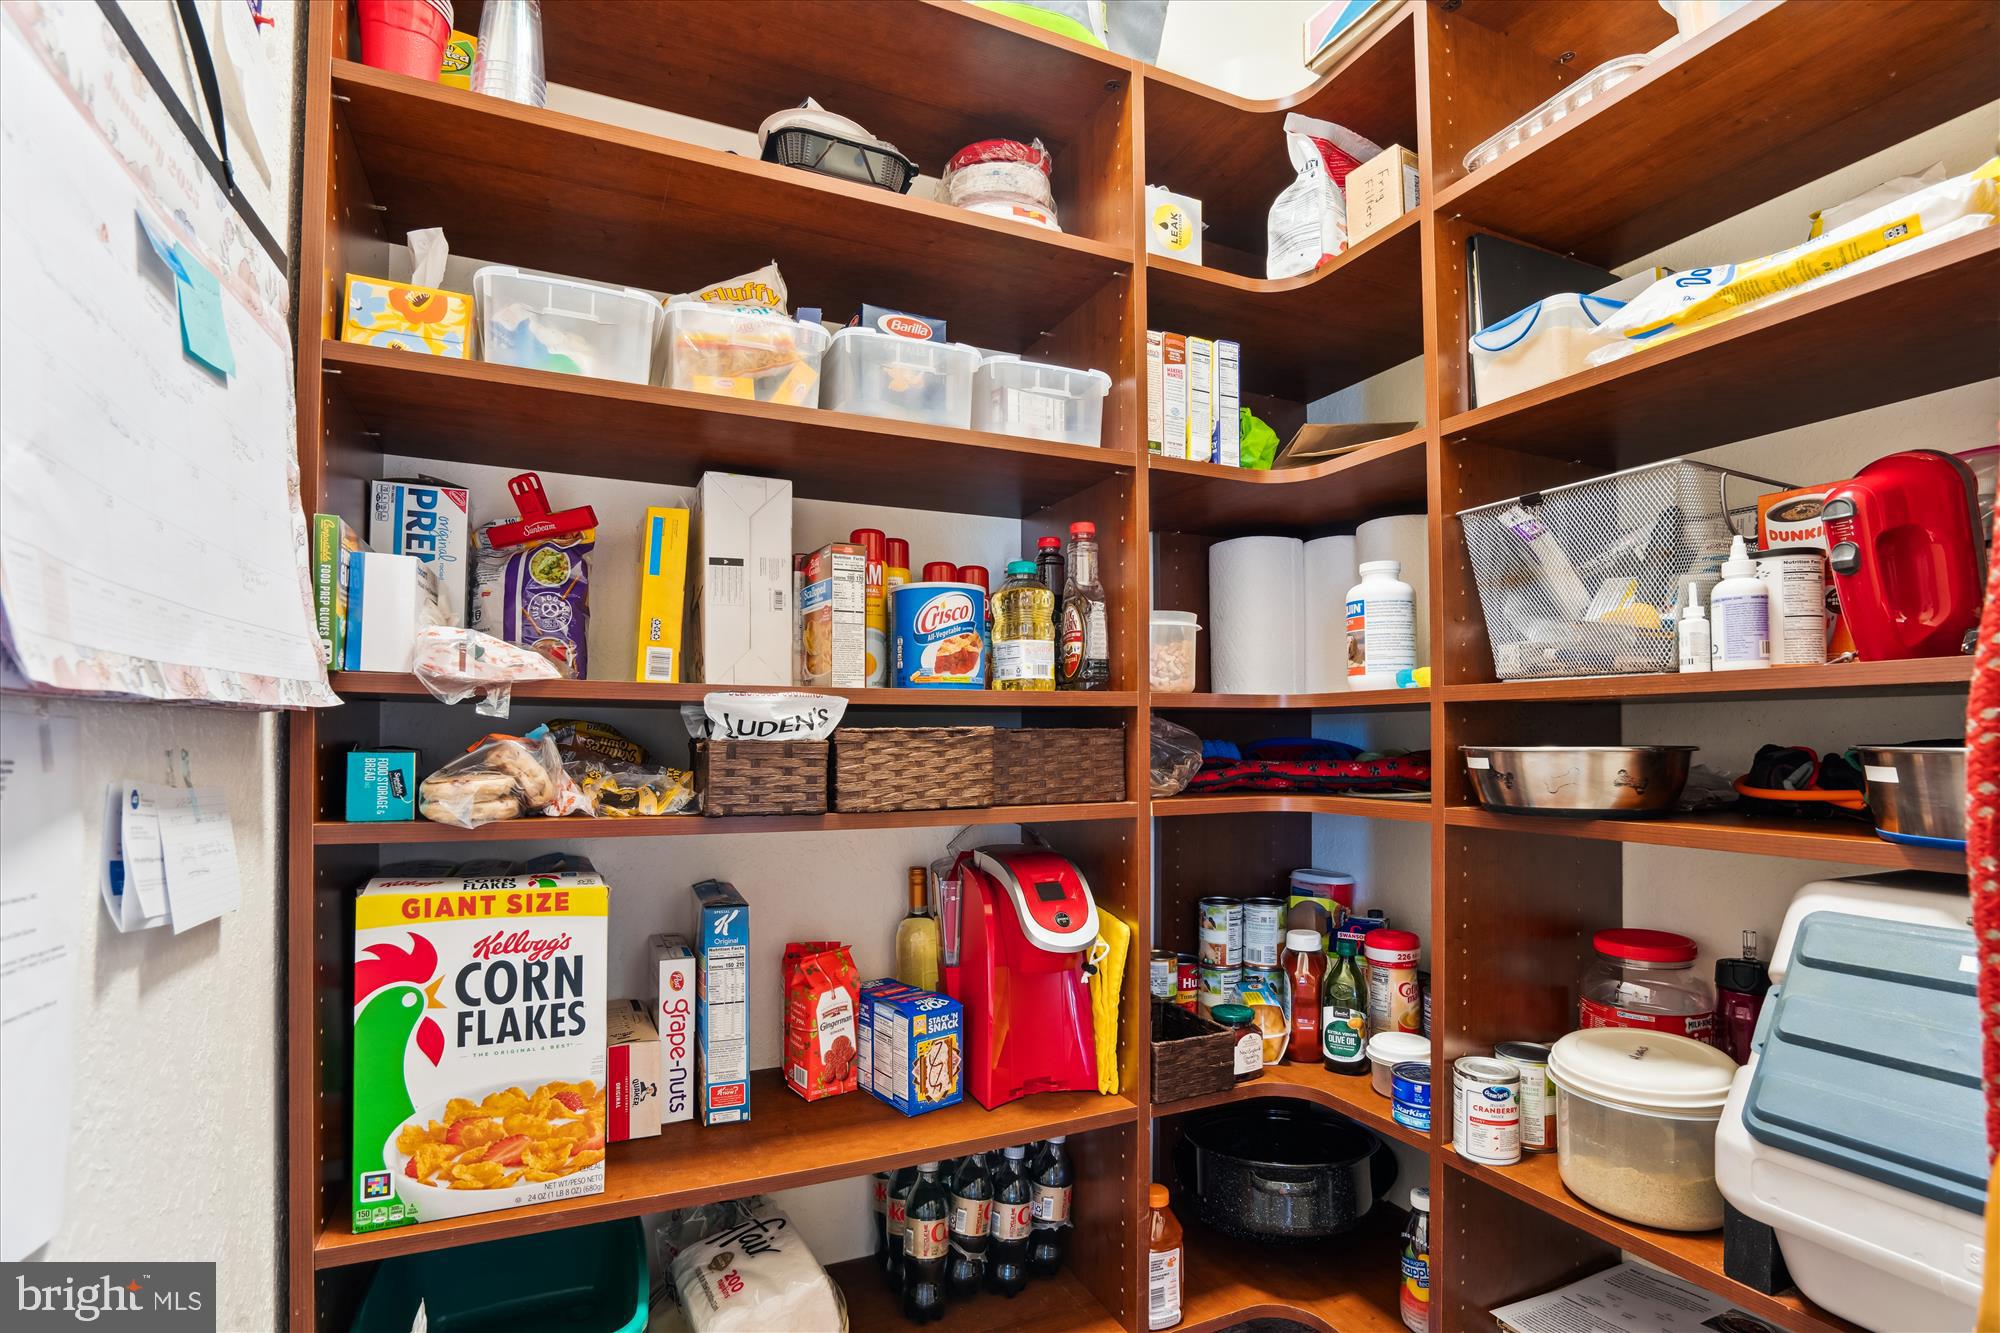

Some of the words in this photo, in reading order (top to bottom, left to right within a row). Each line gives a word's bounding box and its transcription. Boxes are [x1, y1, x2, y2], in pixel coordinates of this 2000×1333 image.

[1170, 212, 1179, 244] LEAK
[700, 282, 780, 306] Fluffy
[891, 318, 929, 337] Barilla
[430, 516, 457, 562] original
[523, 523, 557, 537] Sunbeam
[1768, 526, 1825, 543] DUNKI
[320, 563, 332, 584] FOOD
[319, 585, 331, 607] PREP
[803, 582, 827, 600] Scalloped
[318, 607, 331, 637] GLOVES
[921, 602, 969, 633] Crisco
[927, 625, 962, 642] All-Vegetable
[723, 707, 829, 739] LUDEN'S
[586, 740, 637, 762] Nature's
[364, 757, 376, 781] BREAD
[377, 757, 389, 776] FOOD
[376, 777, 389, 810] STORAGE
[378, 879, 445, 888] Kellogg's
[463, 881, 517, 890] FLAKES
[401, 894, 497, 919] GIANT
[506, 891, 570, 914] SIZE
[713, 909, 740, 936] K
[472, 929, 573, 962] Kellogg's
[713, 937, 739, 946] Original
[1339, 932, 1365, 940] SWANSO
[1397, 953, 1412, 961] 226
[455, 954, 584, 1007] CORN
[456, 1000, 587, 1048] FLAKES
[819, 1015, 853, 1031] Gingerman
[927, 1015, 950, 1025] STACK
[927, 1018, 959, 1034] SNACK
[1328, 1034, 1345, 1045] OLIVE
[1346, 1036, 1357, 1046] OIL
[493, 1047, 537, 1056] ORIGINAL
[663, 998, 690, 1114] grape-nuts
[632, 1078, 640, 1106] QUAKER
[1395, 1104, 1427, 1119] StarKist
[1472, 1104, 1518, 1115] CRANBERRY
[544, 1181, 557, 1191] NET
[557, 1176, 586, 1188] WT/PESO
[586, 1173, 604, 1183] NETO
[527, 1194, 537, 1202] 24
[537, 1192, 547, 1201] OZ
[547, 1191, 554, 1200] (1
[555, 1189, 564, 1198] LB
[564, 1189, 570, 1197] 8
[570, 1186, 582, 1195] OZ)
[582, 1183, 604, 1193] (680g)
[358, 1209, 370, 1218] 150
[716, 1278, 731, 1299] napkins
[723, 1269, 745, 1293] 200
